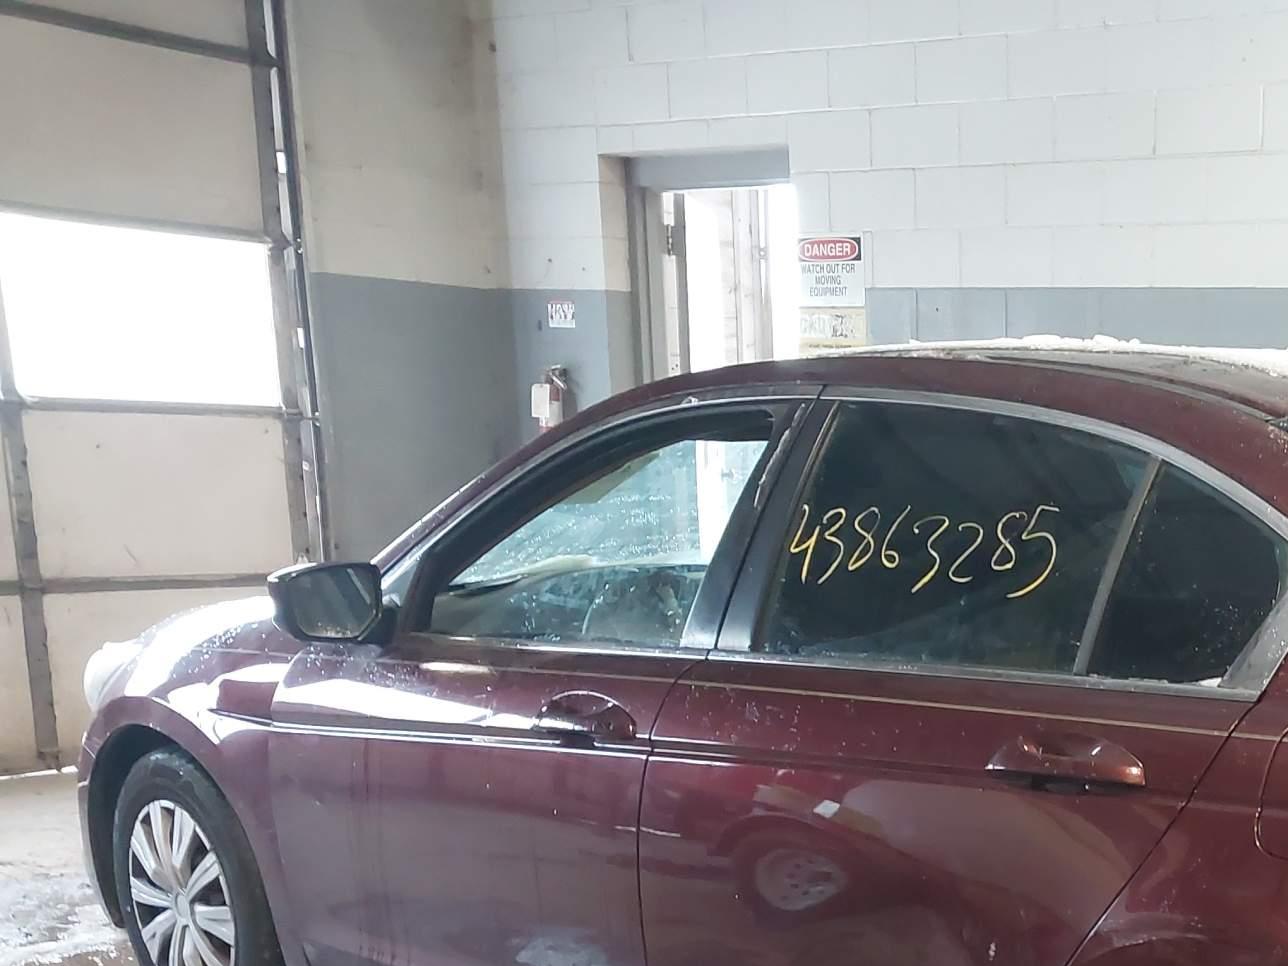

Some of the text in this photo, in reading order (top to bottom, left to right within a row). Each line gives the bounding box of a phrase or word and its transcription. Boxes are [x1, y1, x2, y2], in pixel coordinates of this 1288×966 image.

[804, 242, 851, 257] DANGER
[801, 263, 855, 274] WATCH OUT FOR
[815, 275, 841, 285] MOVING
[809, 286, 847, 297] EQUIPMENT
[789, 503, 1061, 599] 43863285
